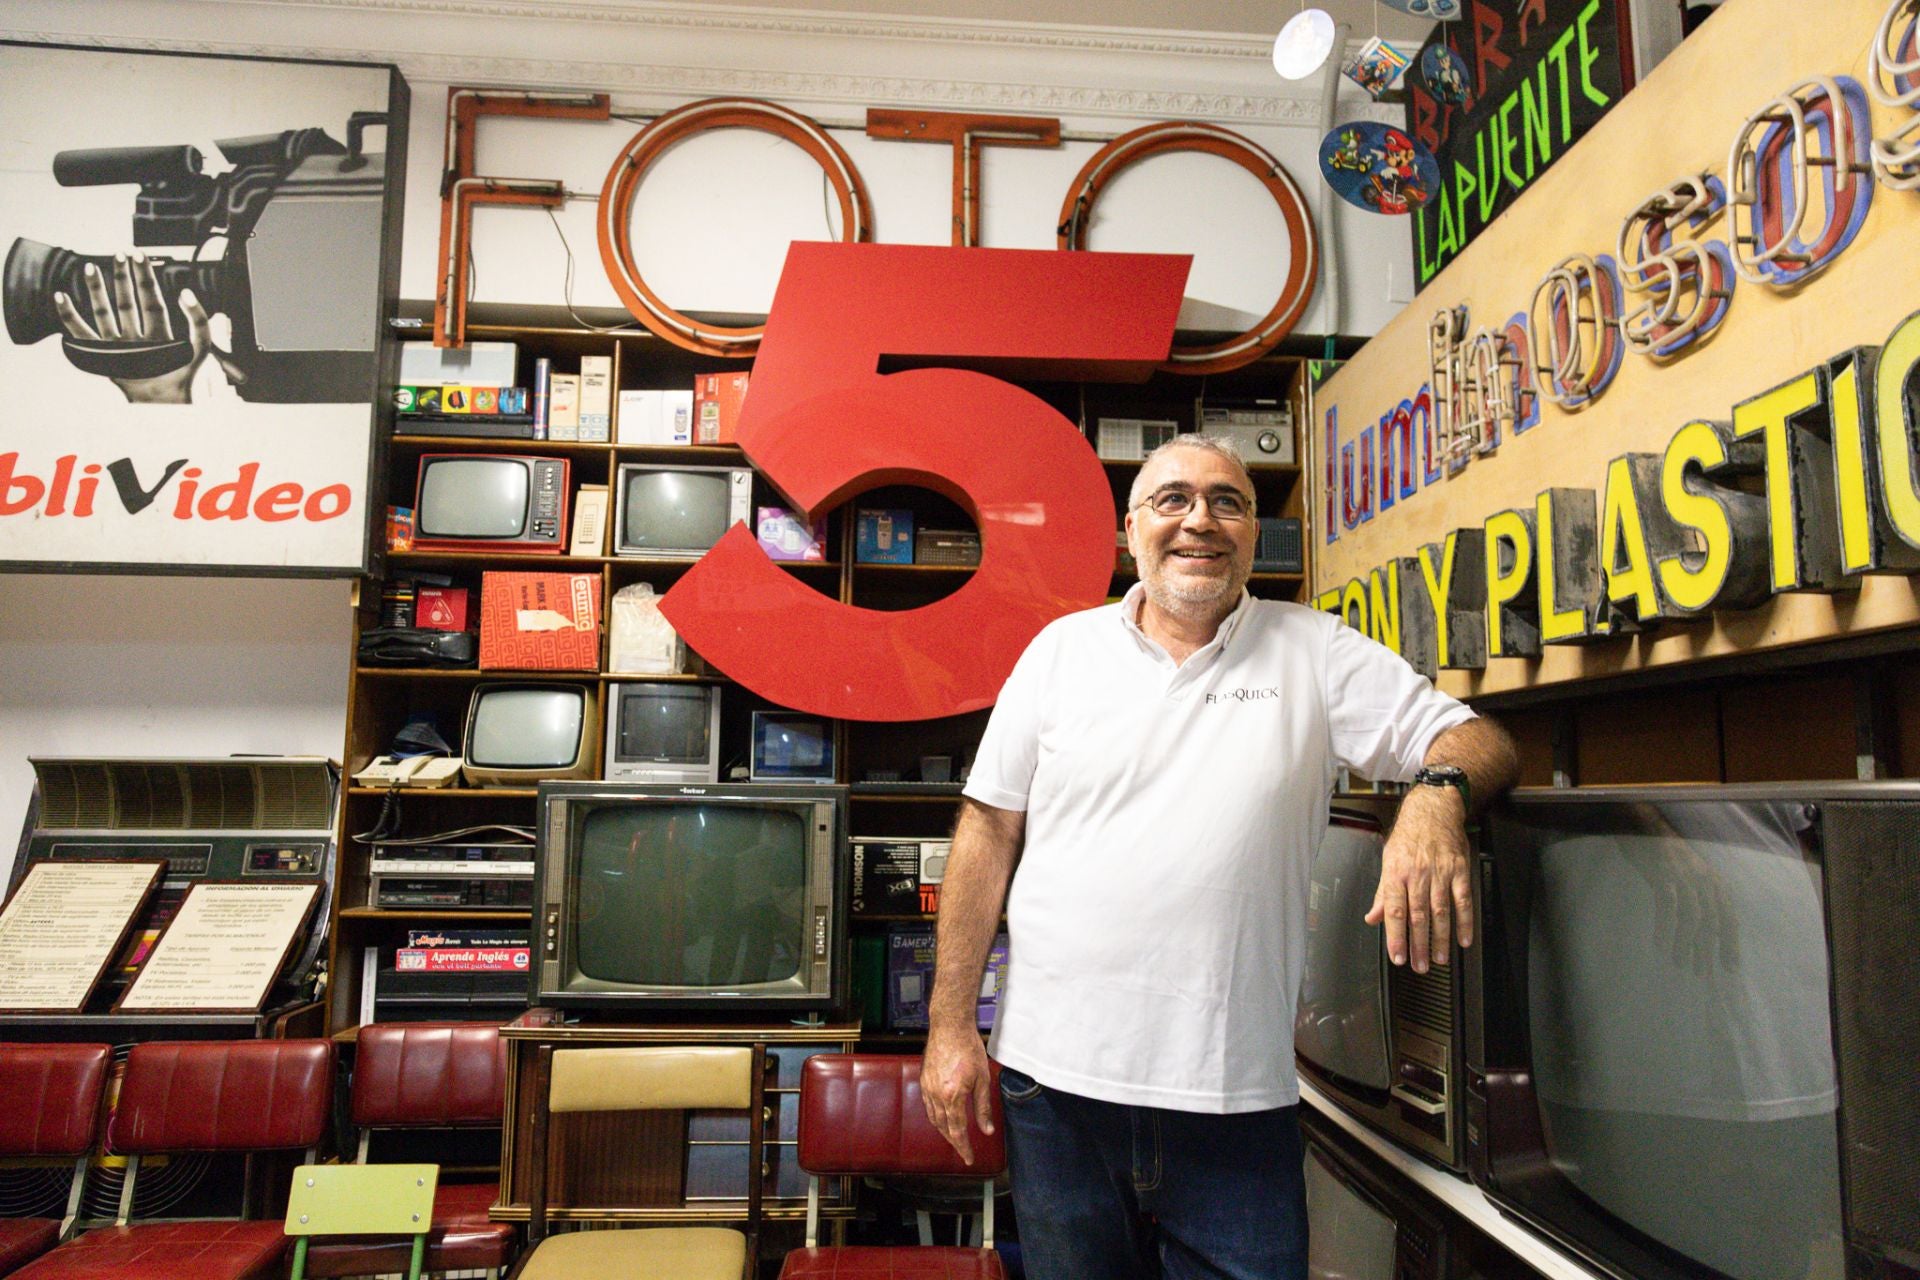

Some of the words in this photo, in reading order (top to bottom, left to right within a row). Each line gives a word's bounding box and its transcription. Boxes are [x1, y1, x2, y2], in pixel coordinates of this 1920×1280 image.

[433, 86, 1319, 375] FOTO
[0, 451, 352, 523] bliVideo
[659, 240, 1193, 721] 5
[1417, 528, 1459, 670] Y
[854, 845, 864, 897] THOMSON
[431, 951, 474, 965] Aprende
[477, 950, 509, 964] Inglés
